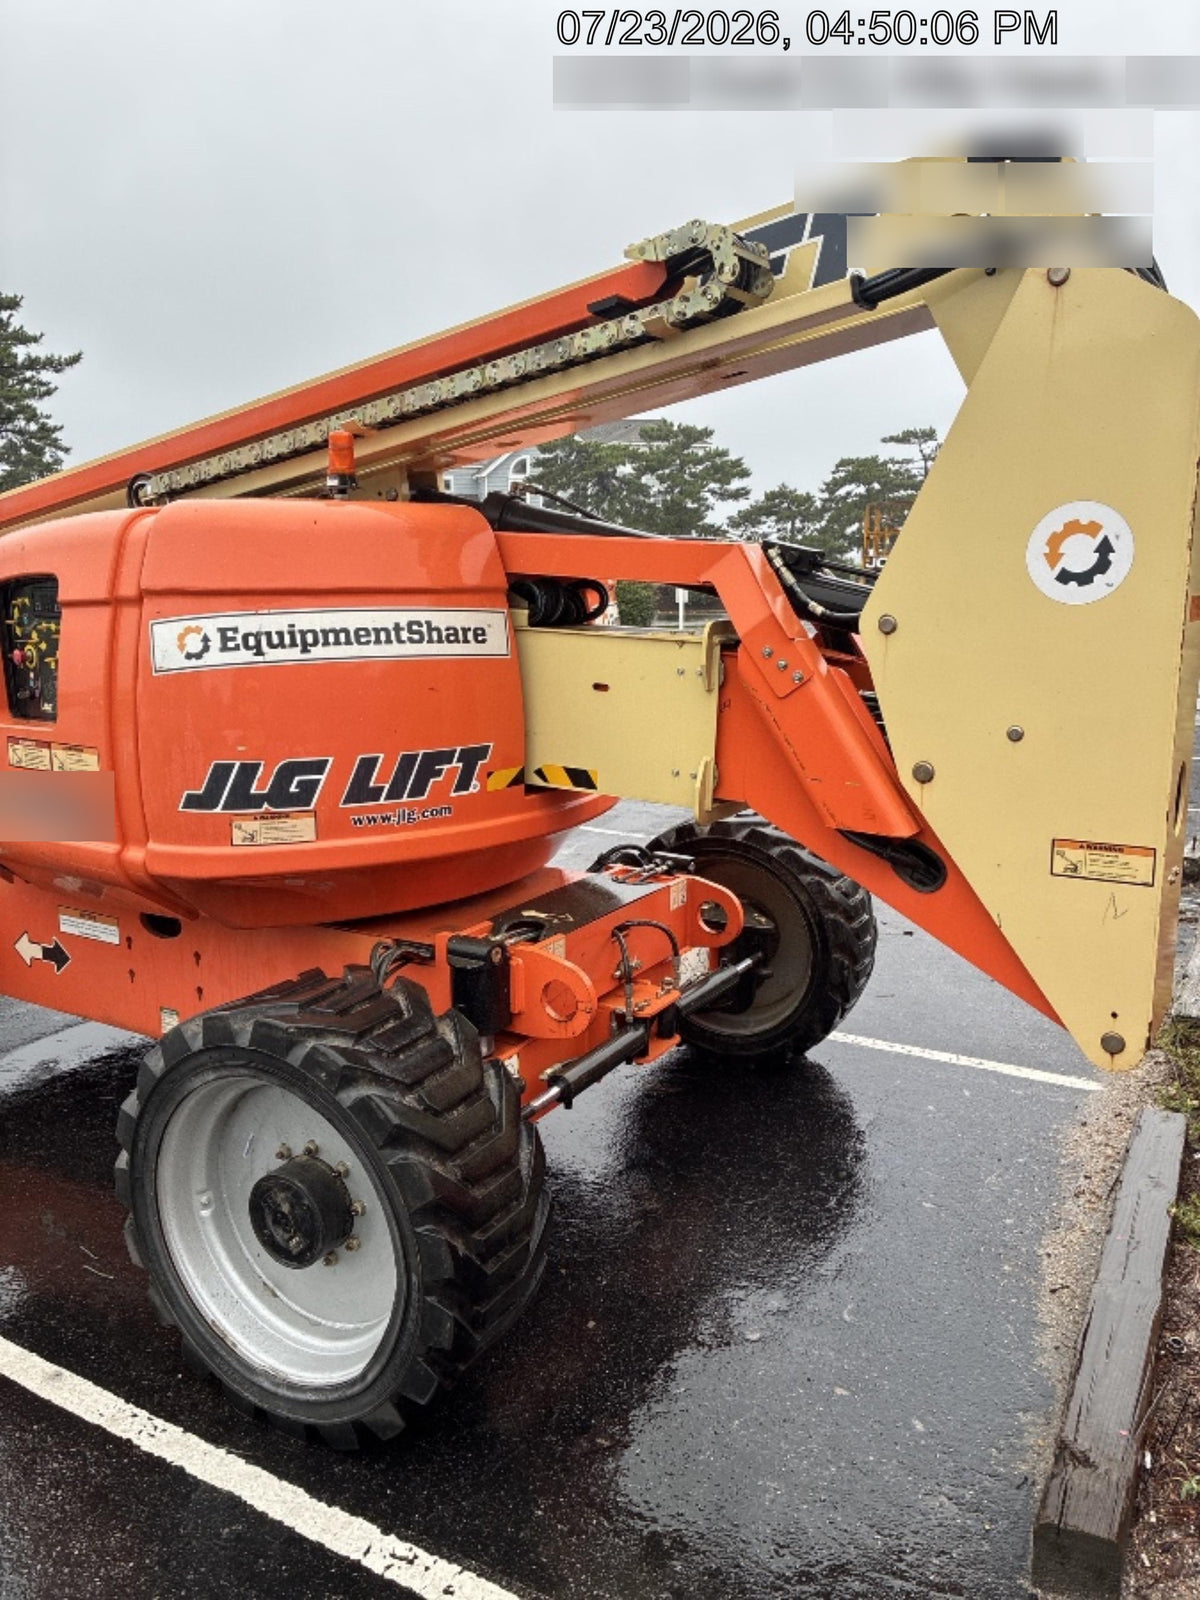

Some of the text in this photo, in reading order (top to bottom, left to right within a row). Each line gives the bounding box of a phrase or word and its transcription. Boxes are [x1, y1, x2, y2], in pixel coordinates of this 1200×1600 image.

[216, 620, 487, 656] EquipmentShare
[178, 757, 334, 812] JLG
[339, 743, 494, 807] LIFT
[351, 805, 453, 826] www.jlg.com
